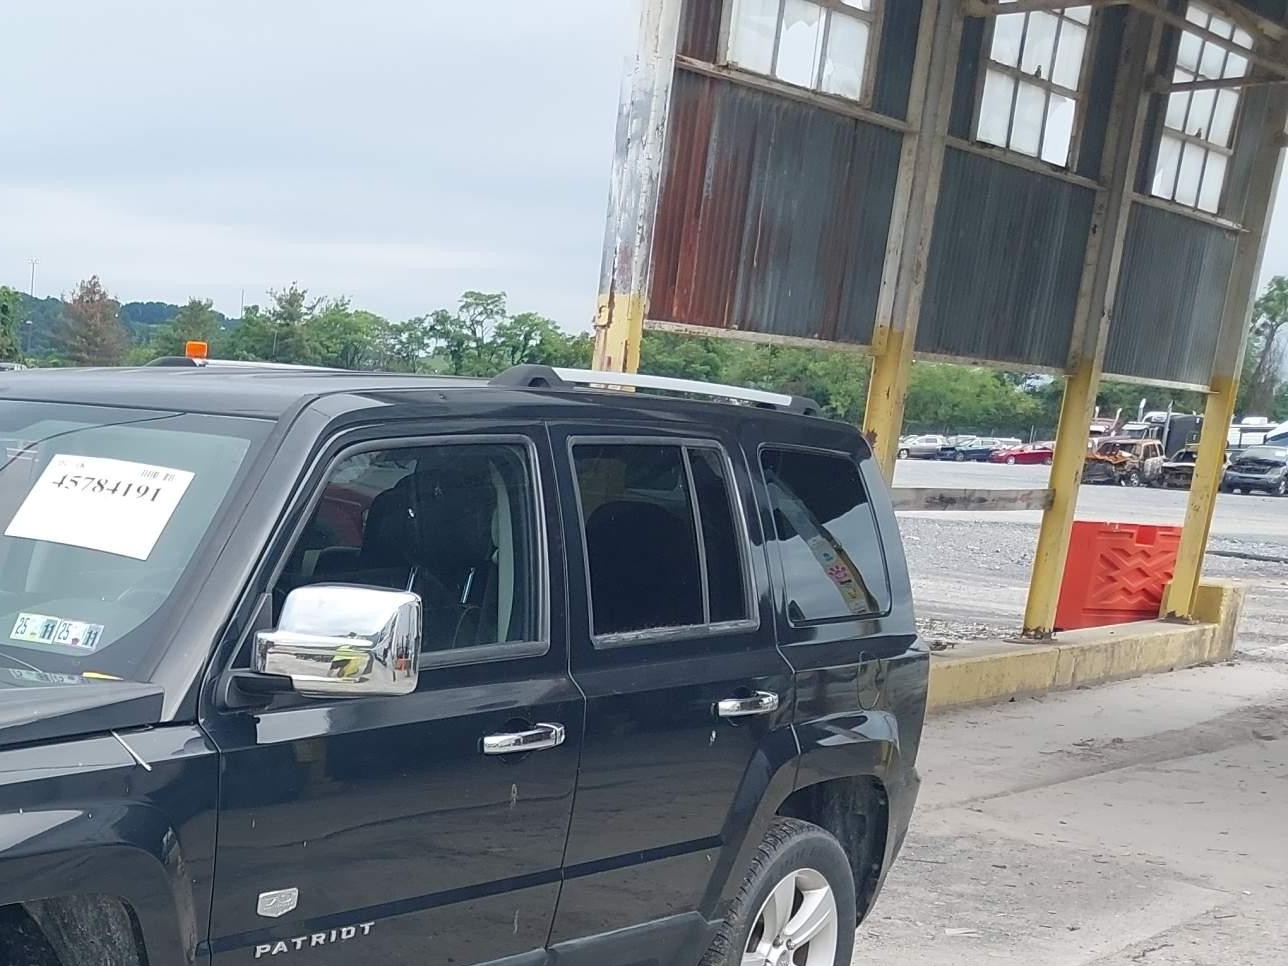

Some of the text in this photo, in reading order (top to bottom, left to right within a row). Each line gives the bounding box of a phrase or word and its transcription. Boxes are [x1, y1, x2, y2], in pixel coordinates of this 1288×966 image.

[52, 473, 162, 502] 45784191
[15, 617, 30, 635] 25
[58, 623, 73, 640] 25
[254, 921, 375, 959] PATRIOT
